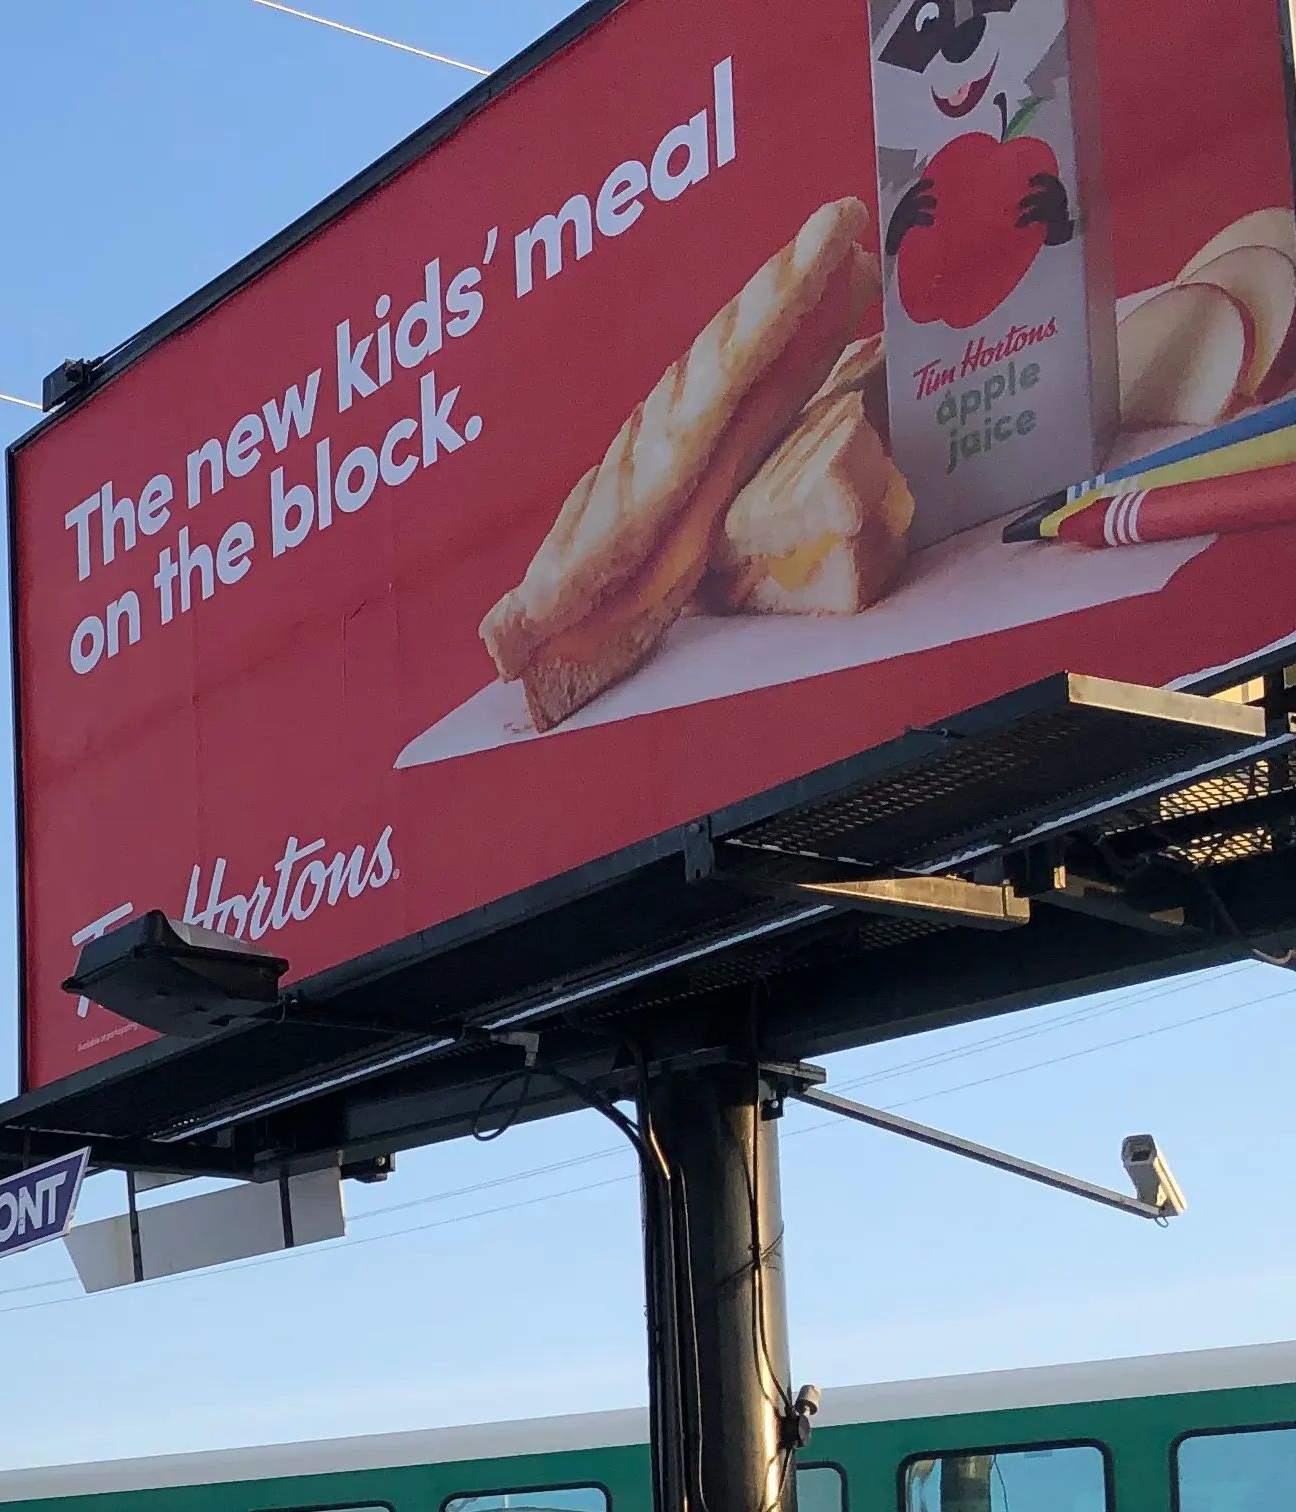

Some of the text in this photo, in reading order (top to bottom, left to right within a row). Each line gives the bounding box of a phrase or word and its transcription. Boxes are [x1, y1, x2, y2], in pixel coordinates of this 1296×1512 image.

[64, 473, 173, 582] The
[186, 368, 322, 510] new
[514, 56, 737, 299] meal
[913, 316, 1057, 400] Tim Hortons
[936, 361, 1041, 426] apple
[946, 409, 1037, 476] juice
[70, 370, 484, 675] on the block.
[182, 825, 395, 941] Hortons
